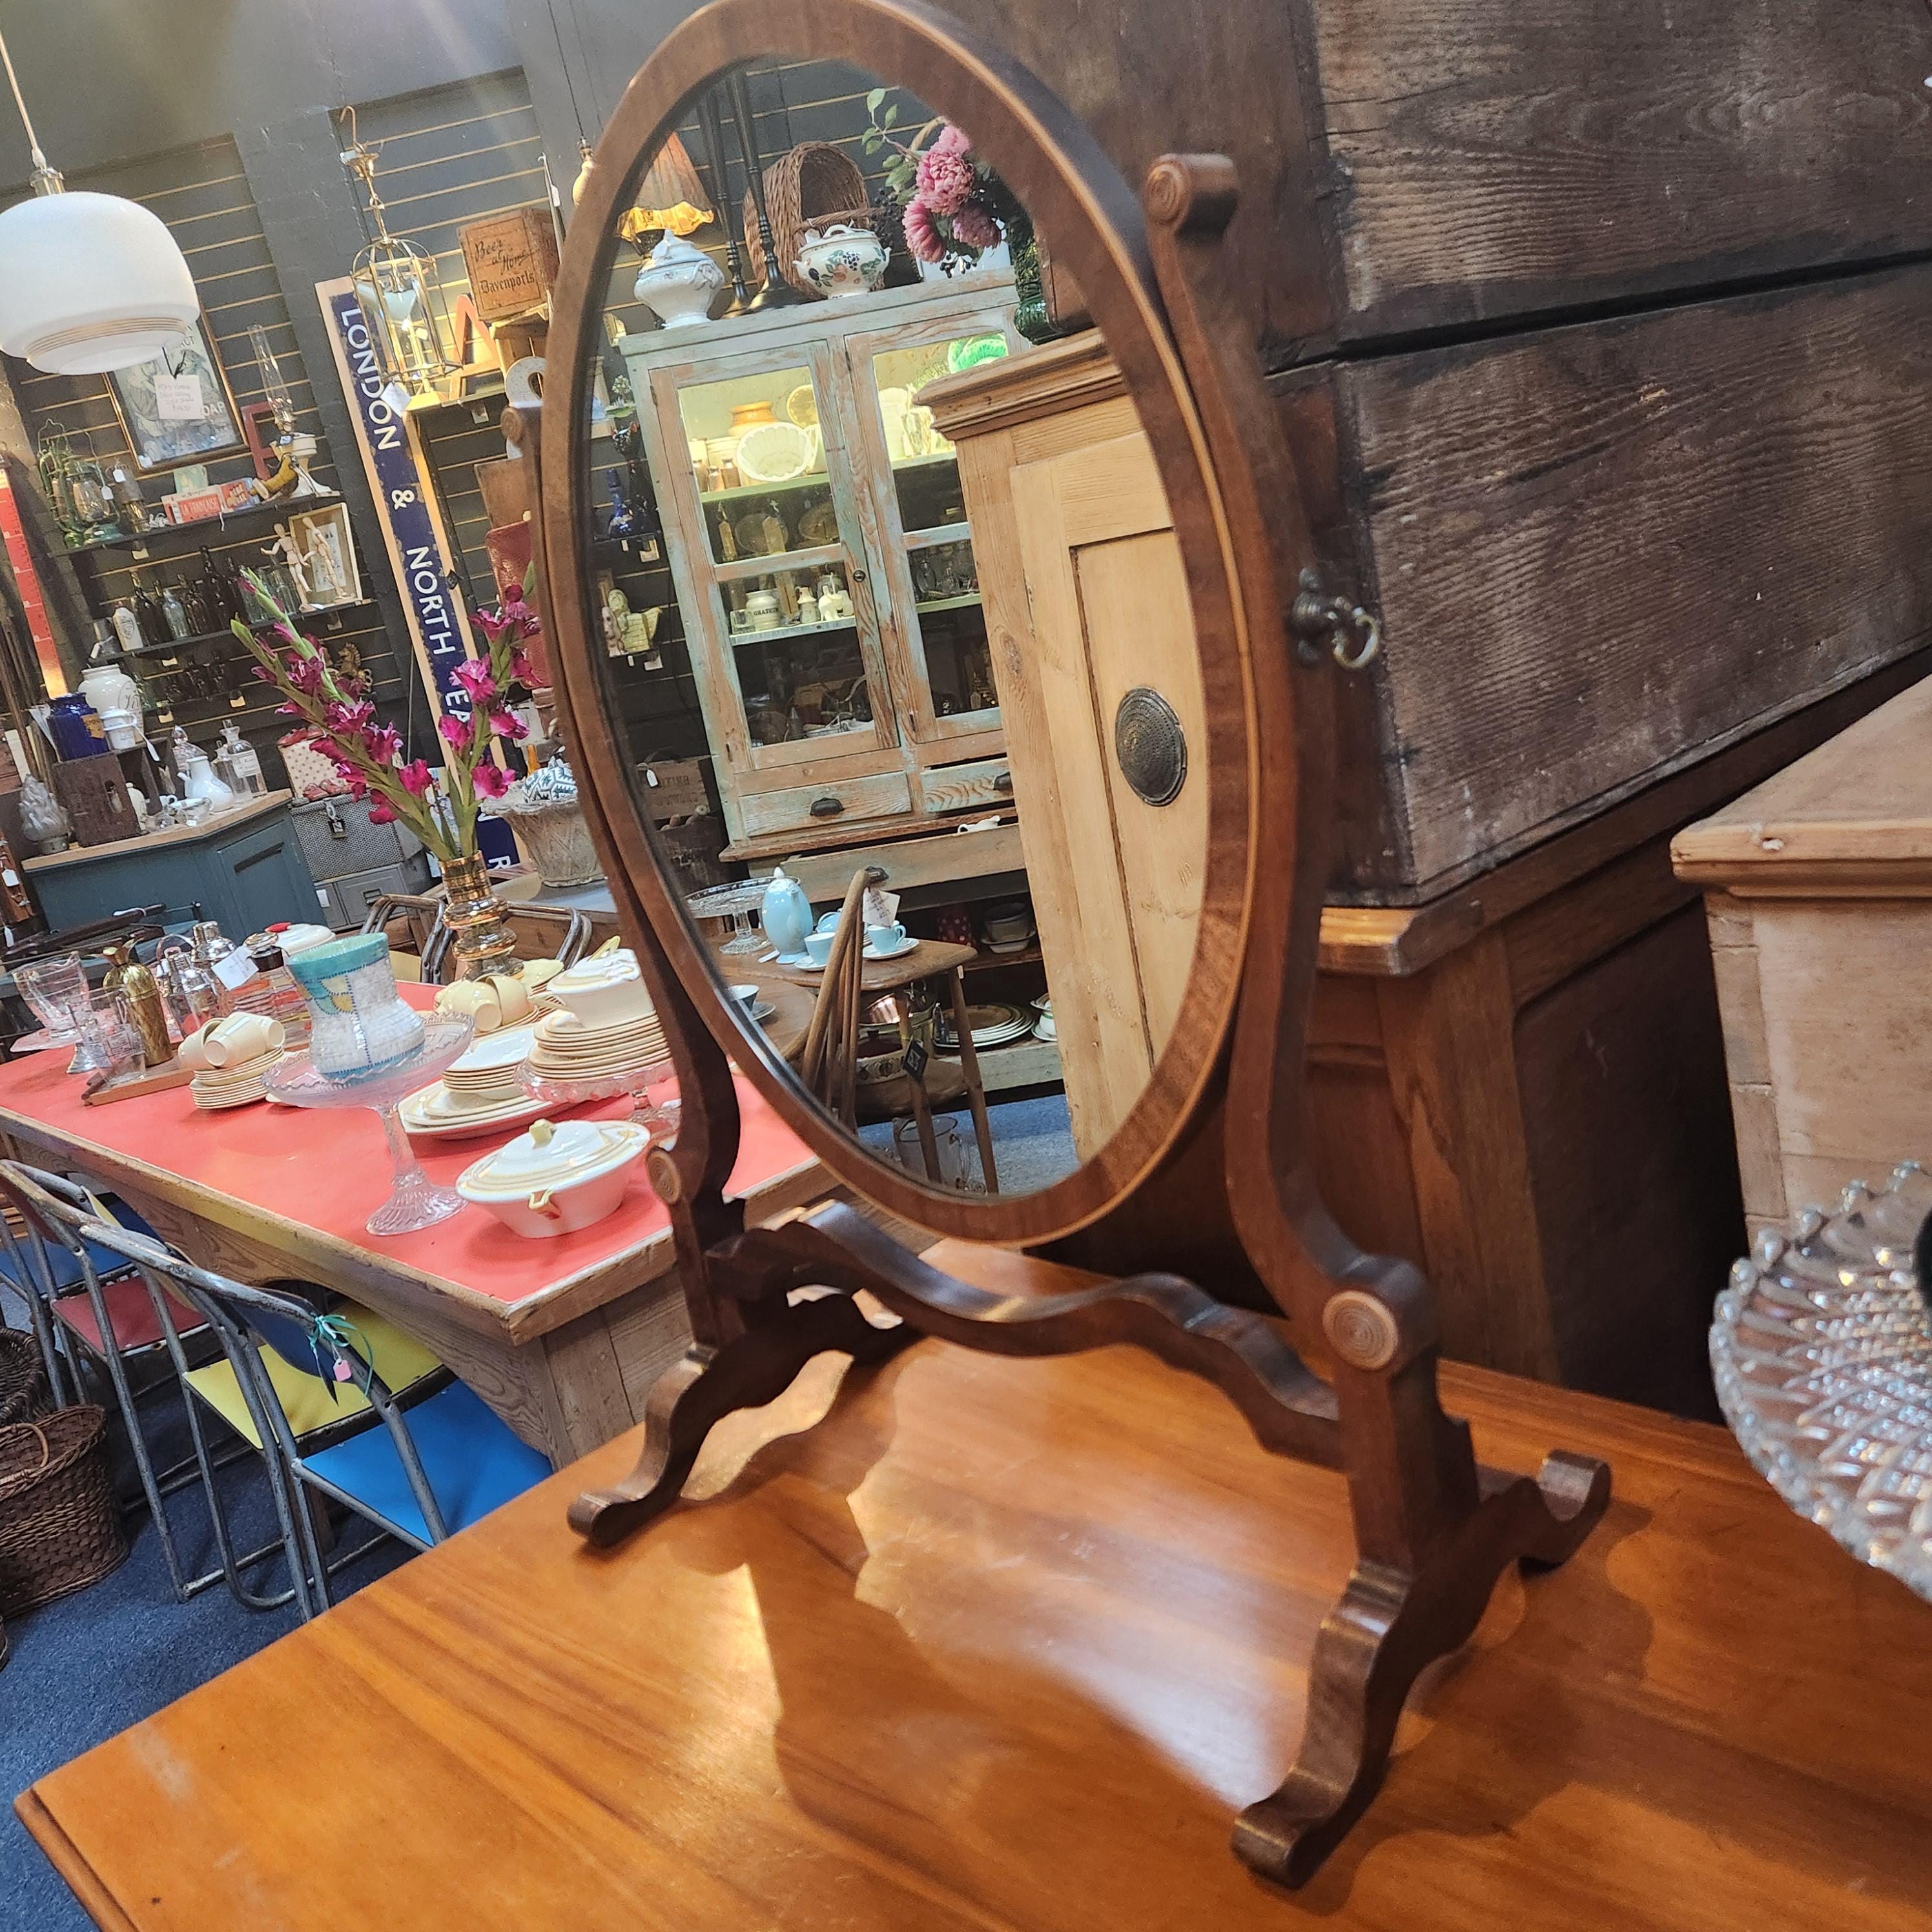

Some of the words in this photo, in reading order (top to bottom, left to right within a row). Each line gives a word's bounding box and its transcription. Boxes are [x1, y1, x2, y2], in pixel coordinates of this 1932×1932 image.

[475, 238, 504, 262] Beer
[500, 249, 535, 276] Home
[480, 271, 535, 294] Davenports
[200, 401, 225, 417] OAP
[341, 308, 401, 450] LONDON
[391, 489, 415, 510] &
[406, 546, 456, 655] NORTH
